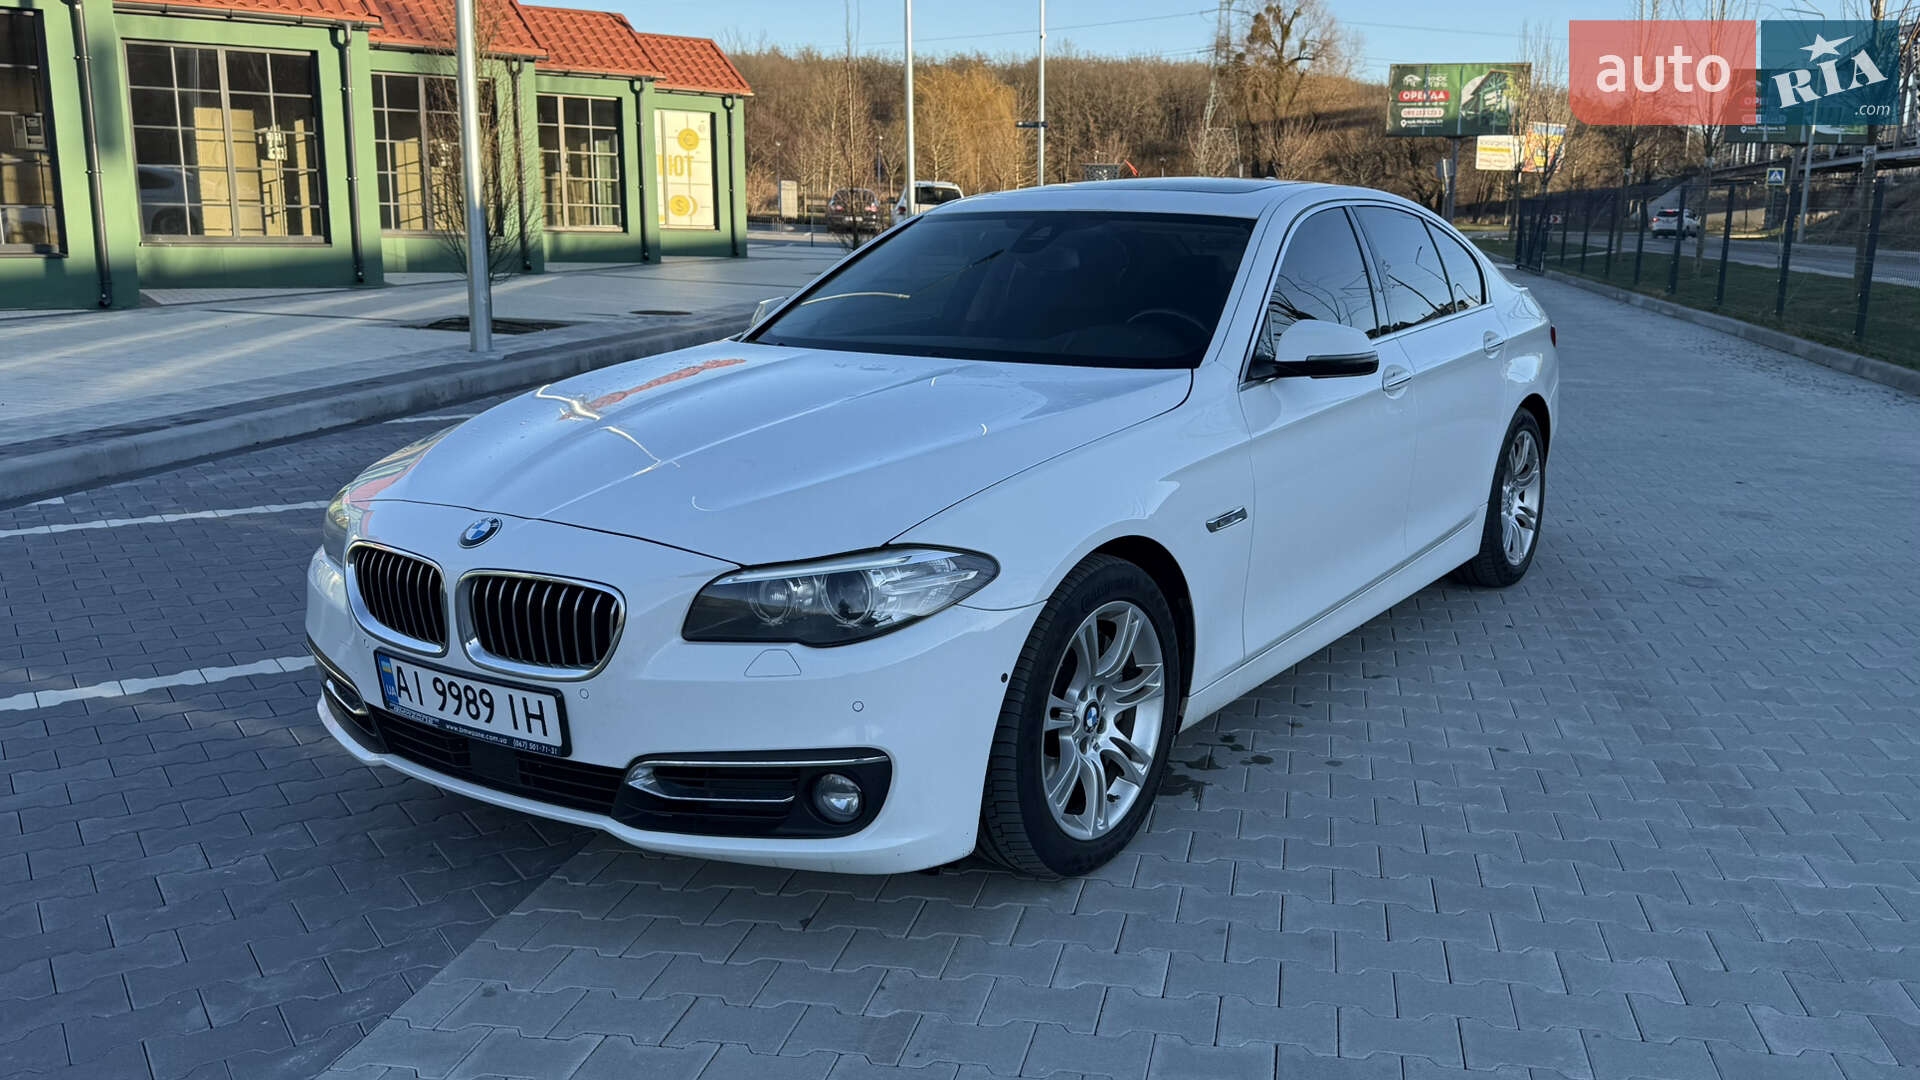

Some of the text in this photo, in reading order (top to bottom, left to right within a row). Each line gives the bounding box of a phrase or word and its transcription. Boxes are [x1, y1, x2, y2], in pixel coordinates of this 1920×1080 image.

[385, 682, 398, 697] UA
[396, 665, 425, 706] AI
[432, 677, 495, 724] 9989
[508, 694, 548, 737] IH
